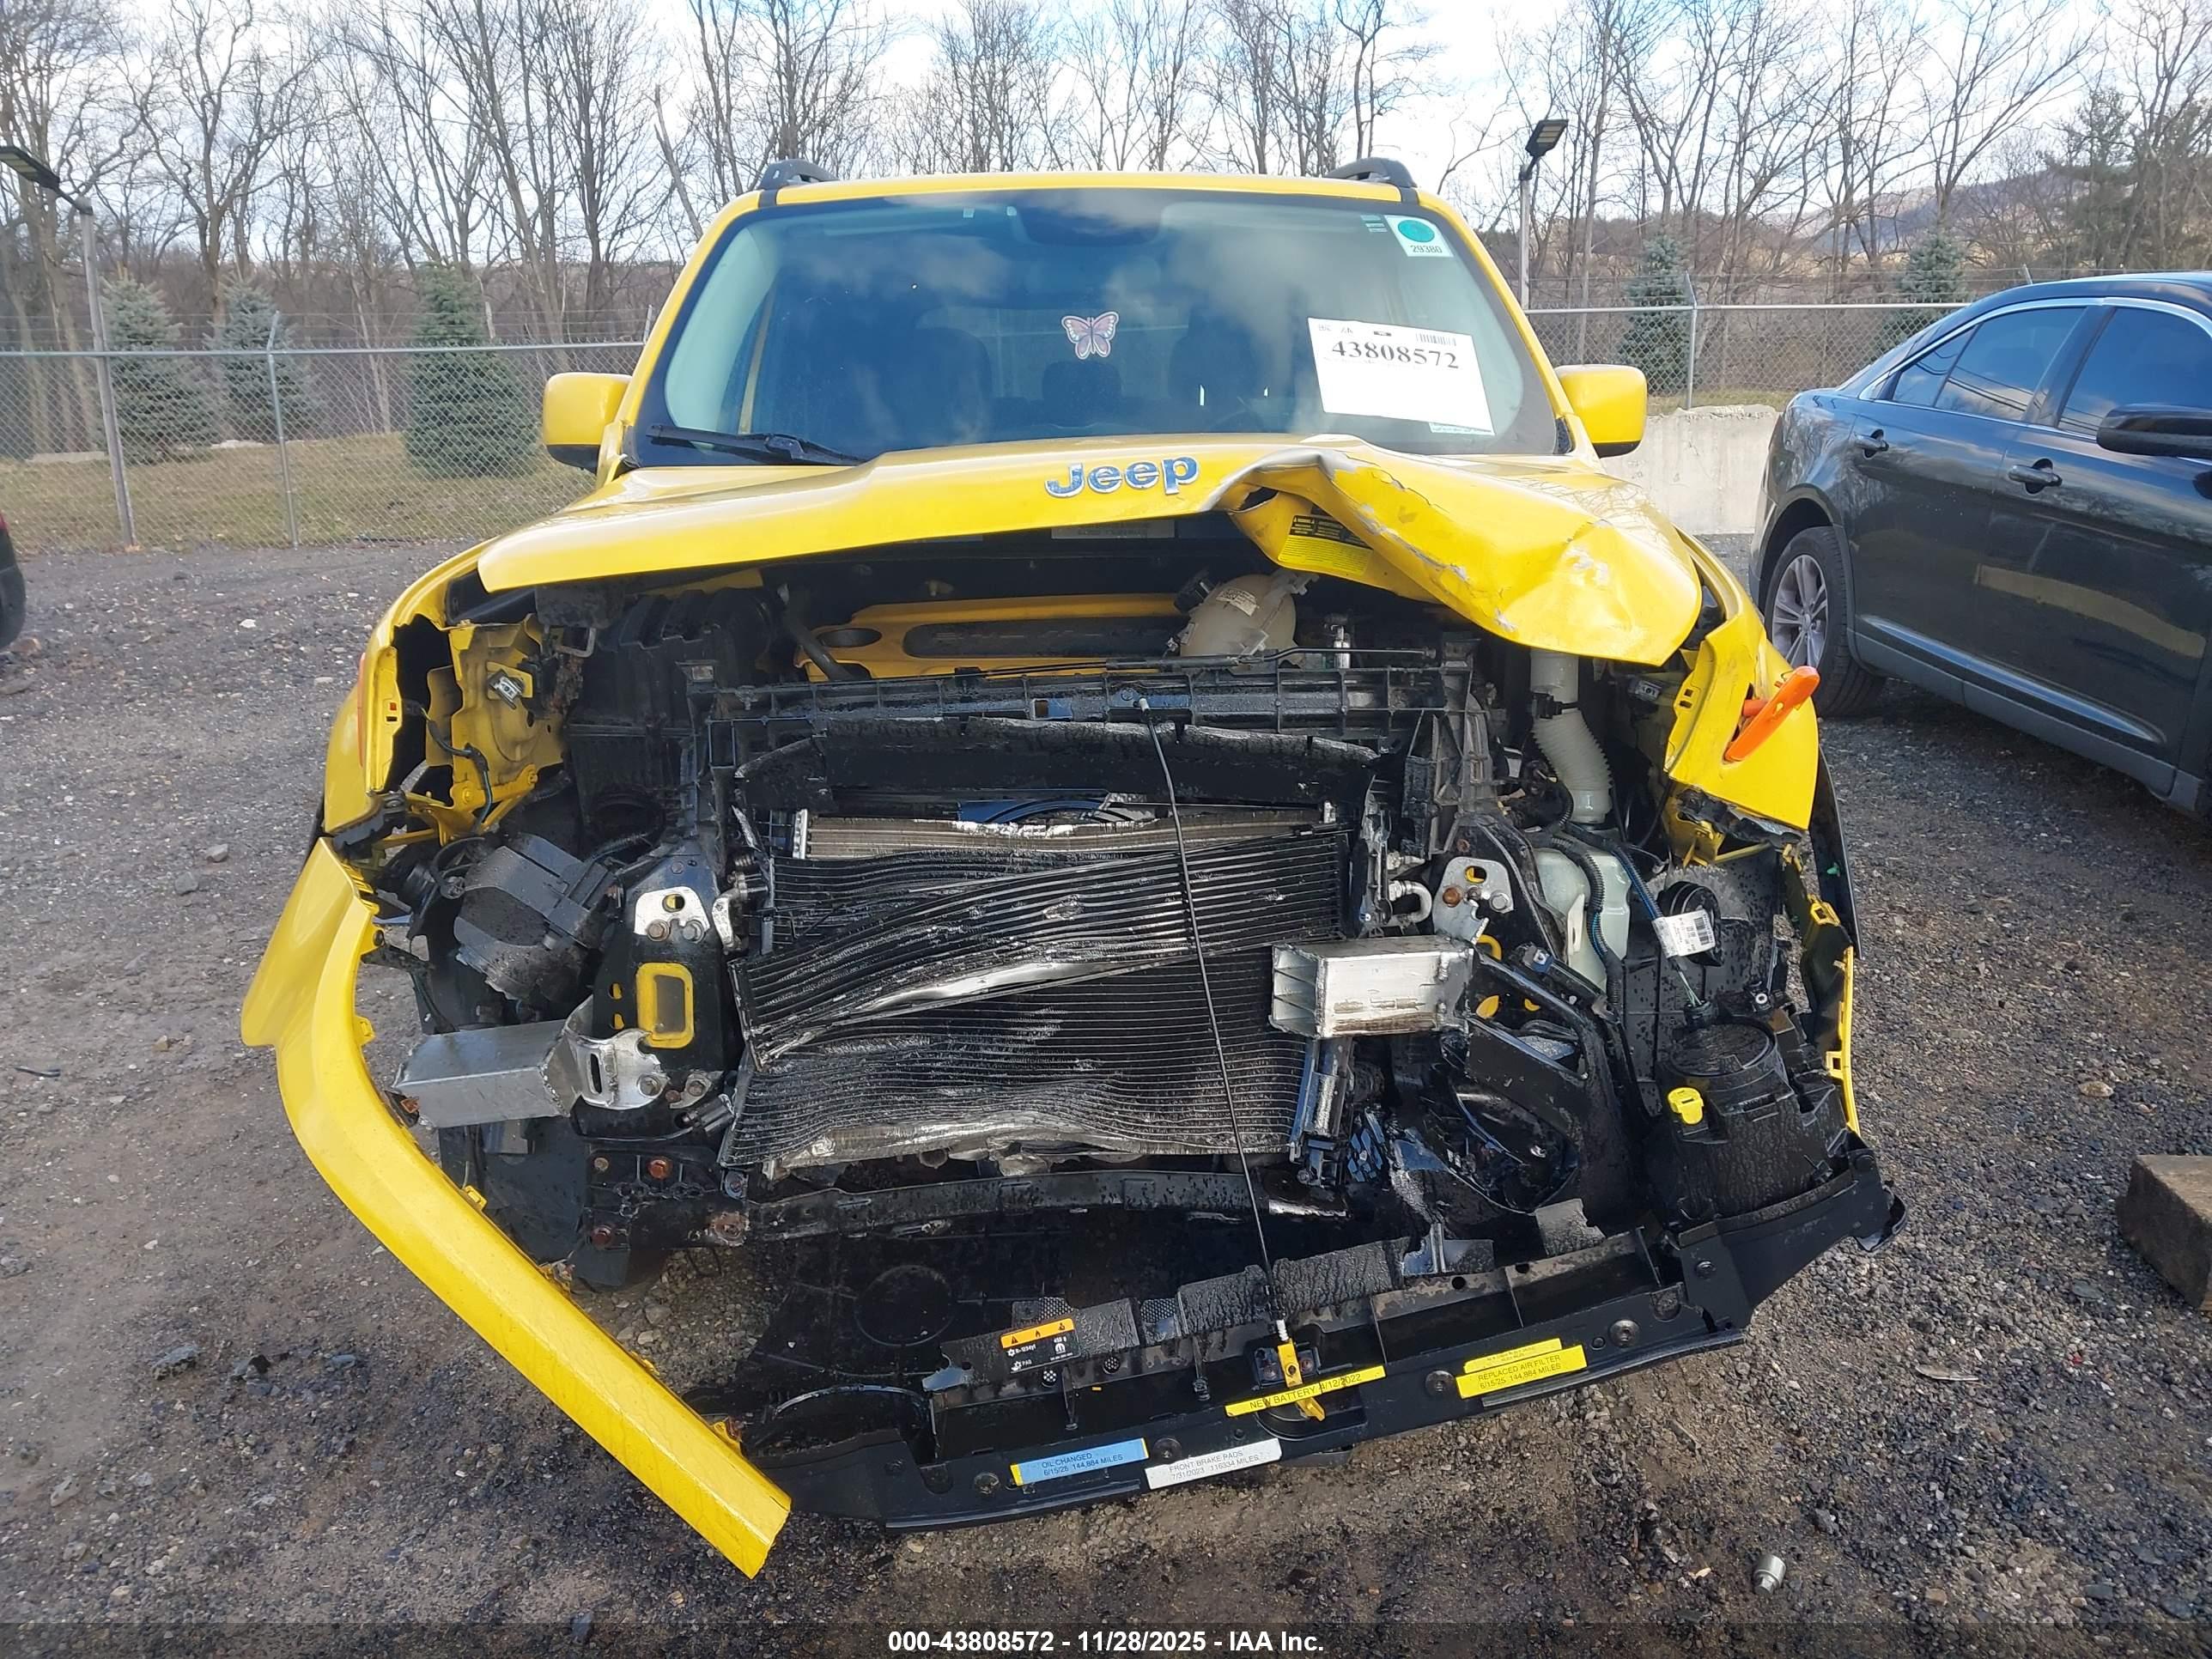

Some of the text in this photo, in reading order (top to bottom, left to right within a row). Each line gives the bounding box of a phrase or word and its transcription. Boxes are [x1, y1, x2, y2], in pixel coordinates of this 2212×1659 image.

[1410, 245, 1443, 253] 29380
[1332, 340, 1459, 369] 43808572
[1044, 456, 1200, 498] Jeep
[1478, 1365, 1518, 1382] REPLACED
[1519, 1361, 1533, 1370] AIR
[1534, 1354, 1561, 1367] FILTER
[1538, 1363, 1562, 1374] MILES
[1249, 1373, 1362, 1409] NEW BATTERY 4/12/2022
[1042, 1452, 1092, 1468] OIL CHANGED
[1100, 1454, 1123, 1464] MILES
[1169, 1449, 1244, 1473] FRONT BRAKE PADS
[1172, 1467, 1205, 1480] 7/31/2023
[1237, 1454, 1260, 1465] MILES
